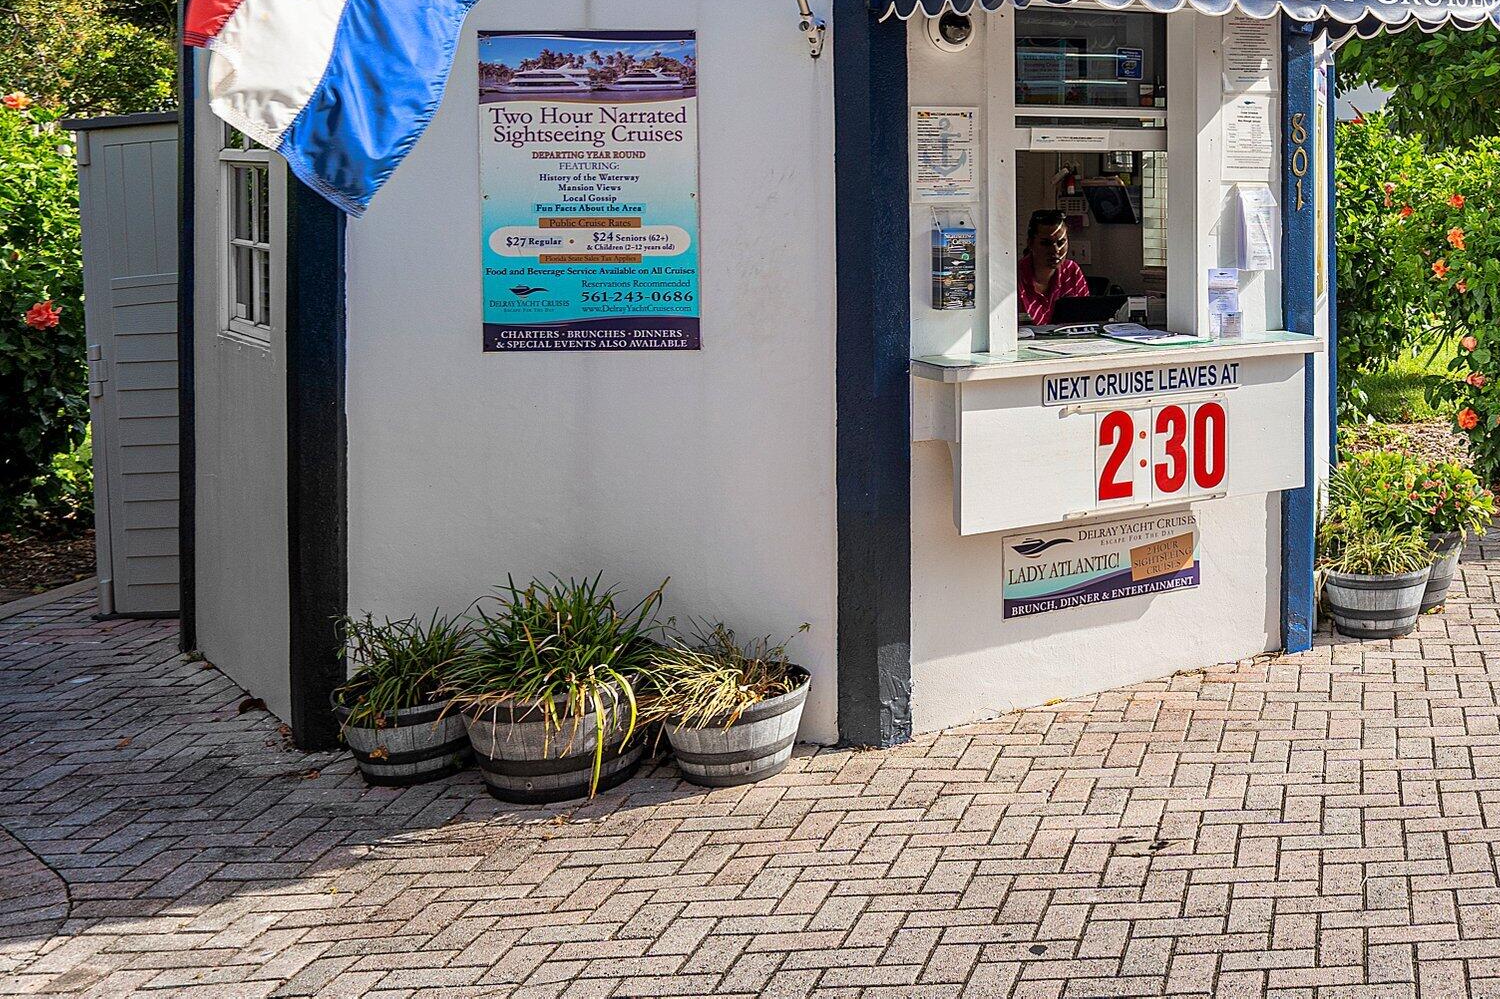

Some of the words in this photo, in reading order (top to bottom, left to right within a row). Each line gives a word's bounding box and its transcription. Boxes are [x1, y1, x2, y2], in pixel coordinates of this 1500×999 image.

[489, 107, 533, 124] Two
[540, 107, 593, 124] Hour
[598, 106, 688, 124] Narrated
[494, 125, 605, 148] Sightseeing
[611, 124, 683, 142] Cruises
[532, 151, 584, 159] DEPARTING
[585, 151, 611, 159] YEAR
[613, 151, 646, 159] ROUND
[559, 162, 620, 170] FEATURING:
[1292, 113, 1308, 212] 801
[539, 174, 571, 183] History
[599, 174, 640, 183] Waterway
[558, 184, 594, 192] Mansion
[596, 184, 621, 192] Views
[563, 194, 586, 202] Local
[588, 194, 617, 204] Gossip
[536, 204, 553, 212] Fun
[555, 204, 577, 212] Facts
[579, 204, 604, 212] About
[606, 204, 620, 212] the
[622, 204, 642, 212] Area
[550, 219, 576, 227] Public
[578, 219, 606, 227] Cruise
[608, 219, 632, 227] Rates
[506, 236, 526, 248] $27
[528, 237, 562, 247] Regular
[593, 231, 614, 243] $24
[616, 234, 647, 242] Seniors
[648, 234, 669, 243] (62+)
[486, 267, 506, 275] Food
[508, 267, 525, 275] and
[527, 267, 566, 277] Beverage
[567, 267, 597, 275] Service
[599, 267, 637, 275] Available
[651, 267, 663, 275] All
[664, 267, 695, 275] Cruises
[582, 280, 631, 288] Reservations
[633, 280, 691, 288] Recommended
[581, 291, 693, 303] 561-243-0686
[582, 305, 692, 314] www.DelrayYachtCruises.com
[501, 331, 559, 339] CHARTERS
[567, 331, 626, 339] BRUNCHES
[634, 330, 683, 338] DINNERS
[496, 340, 505, 348] &
[507, 340, 553, 348] SPECIAL
[554, 340, 596, 348] EVENTS
[599, 340, 627, 348] ALSO
[629, 340, 688, 348] AVAILABLE
[1047, 376, 1090, 401] NEXT
[1095, 371, 1154, 396] CRUISE
[1159, 365, 1217, 390] LEAVES
[1221, 362, 1240, 385] AT
[1099, 402, 1226, 501] 2:30
[1078, 527, 1118, 541] DELRAY
[1119, 521, 1155, 536] YACHT
[1153, 540, 1179, 554] HOUR
[1008, 564, 1047, 586] LADY
[1049, 552, 1120, 579] ATLANTIC!
[1146, 560, 1181, 575] CRUISES
[1012, 601, 1058, 616] BRUNCH,
[1060, 593, 1100, 607] DINNER
[1102, 592, 1110, 600] &
[1111, 576, 1194, 598] ENTERTAINMENT
